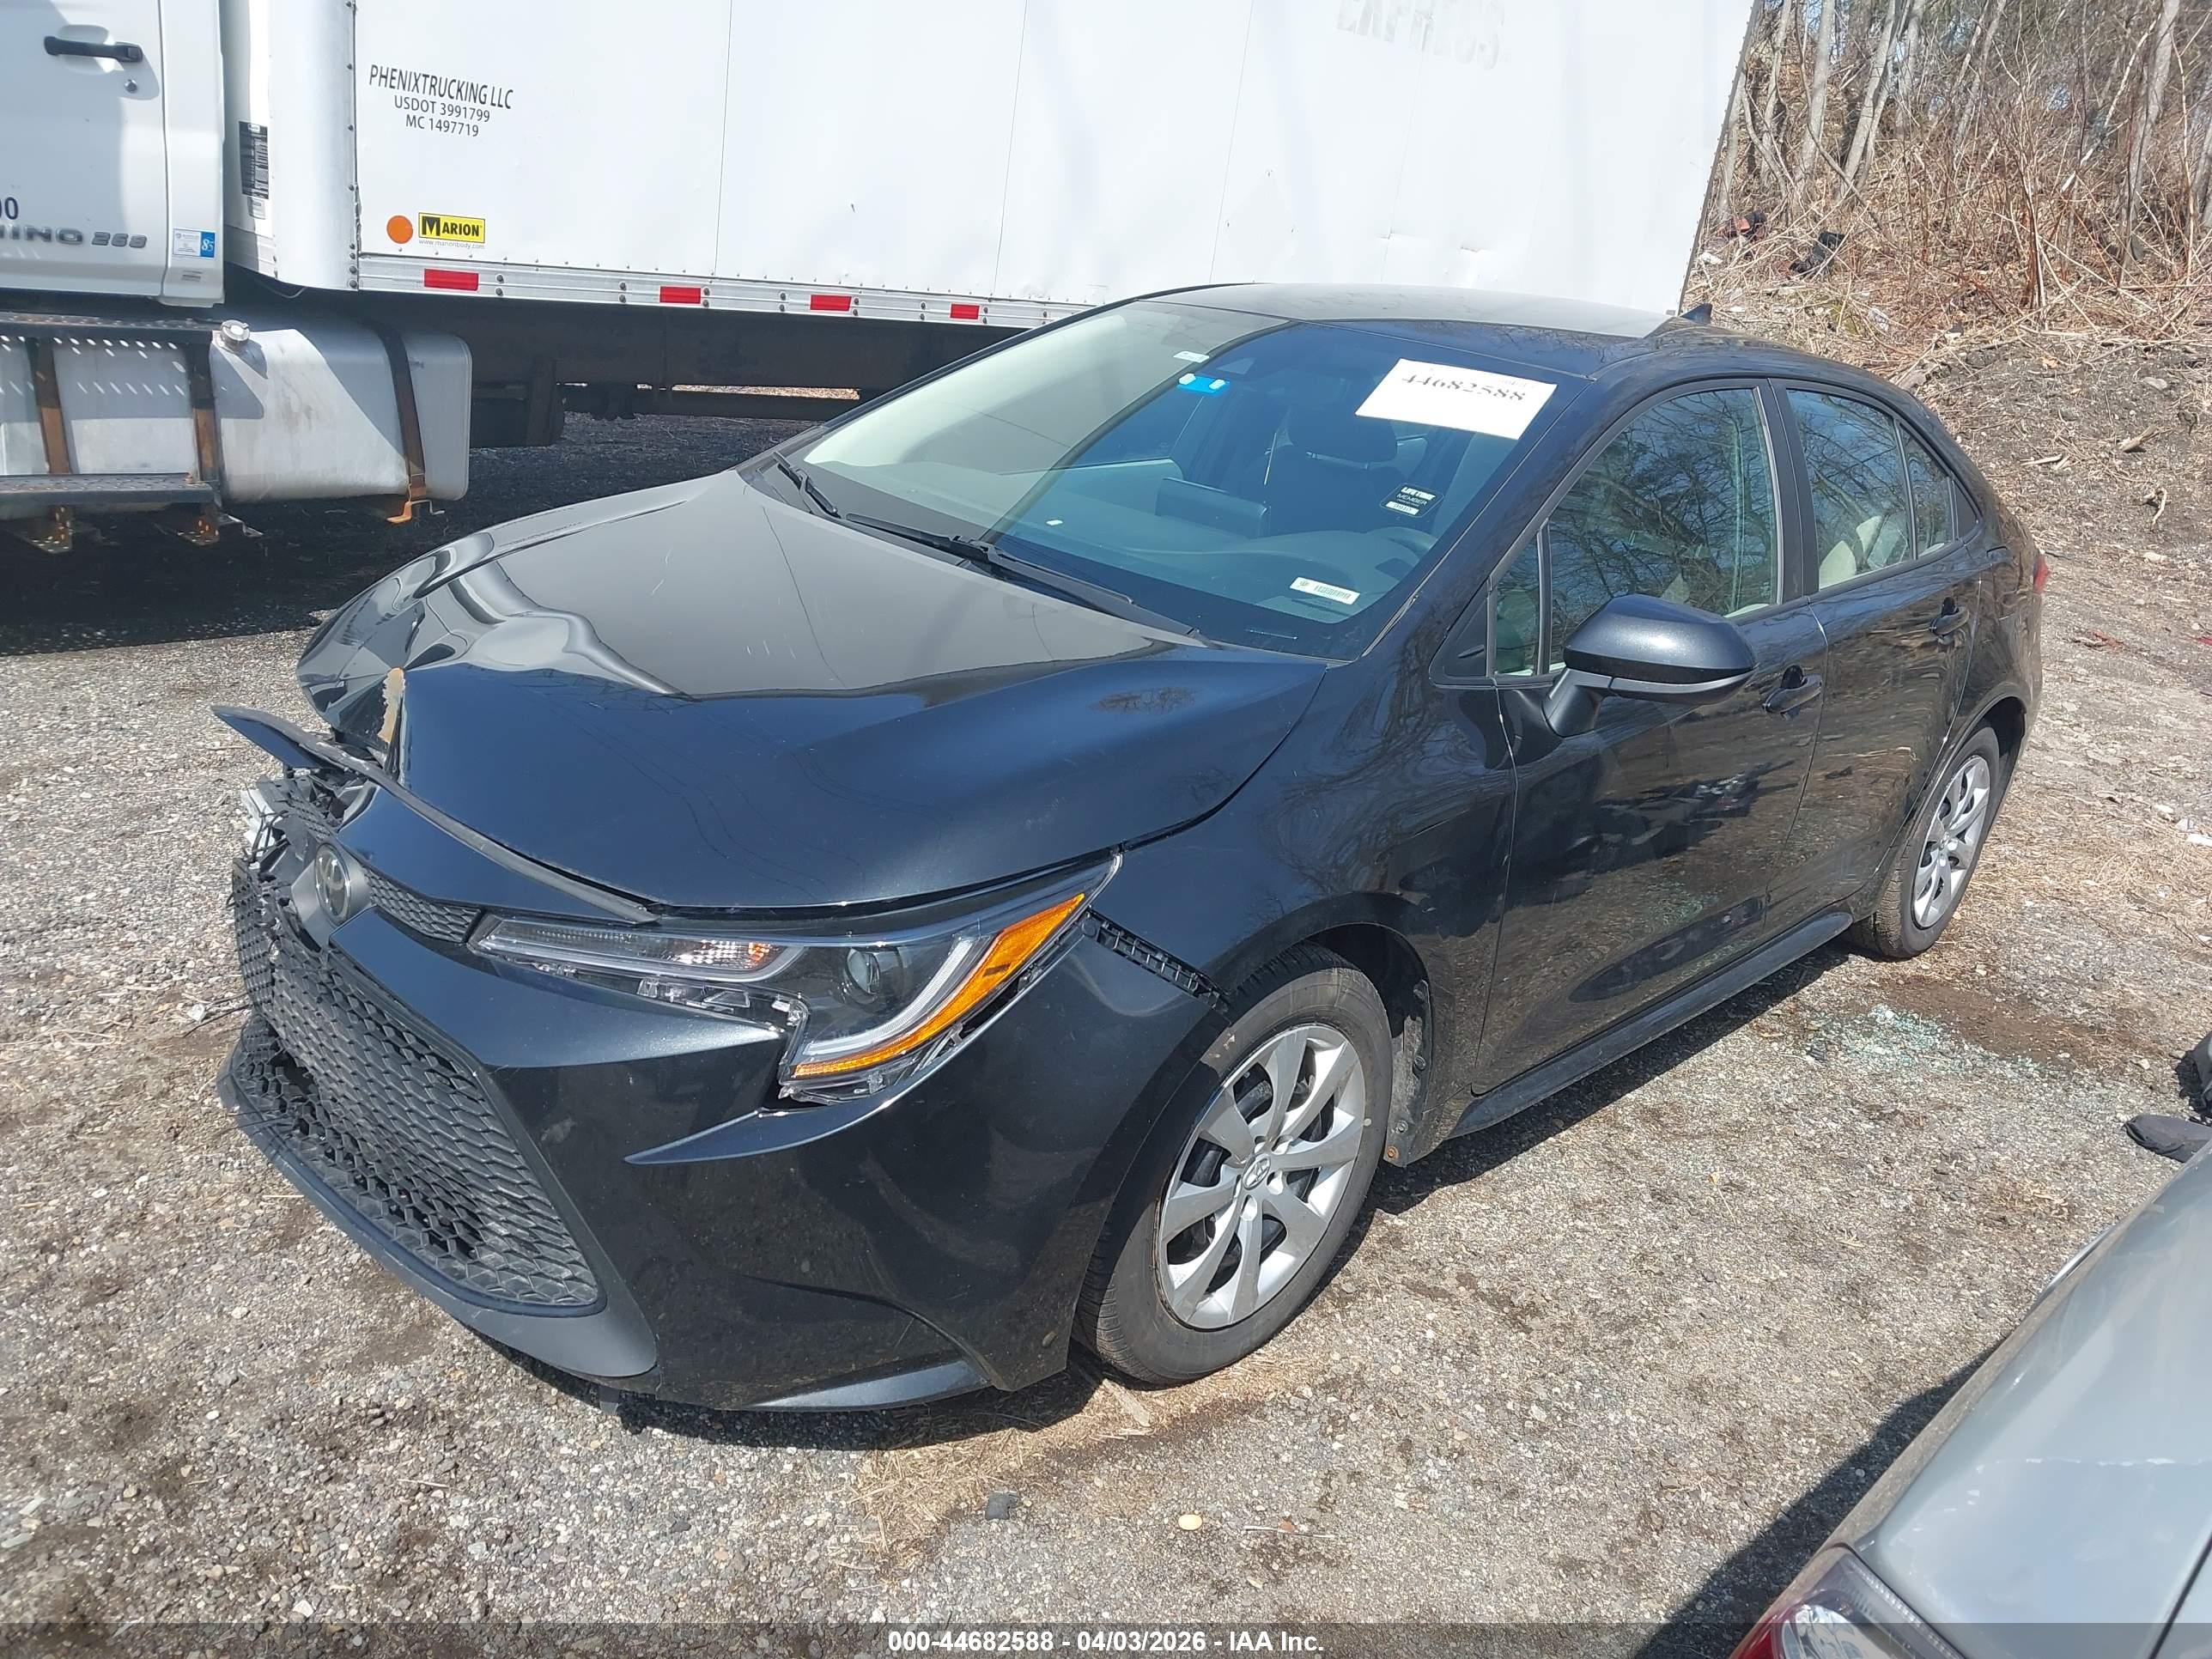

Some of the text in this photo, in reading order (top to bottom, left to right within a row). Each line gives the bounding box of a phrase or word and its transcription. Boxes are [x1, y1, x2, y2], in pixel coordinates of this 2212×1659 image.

[369, 64, 514, 109] PHENIXTRUCKING LLC
[394, 94, 490, 122] USDOT 3991799
[405, 113, 479, 137] MC 1497719
[0, 197, 19, 220] 0
[422, 216, 480, 237] MARION
[1402, 374, 1525, 400] 44682588
